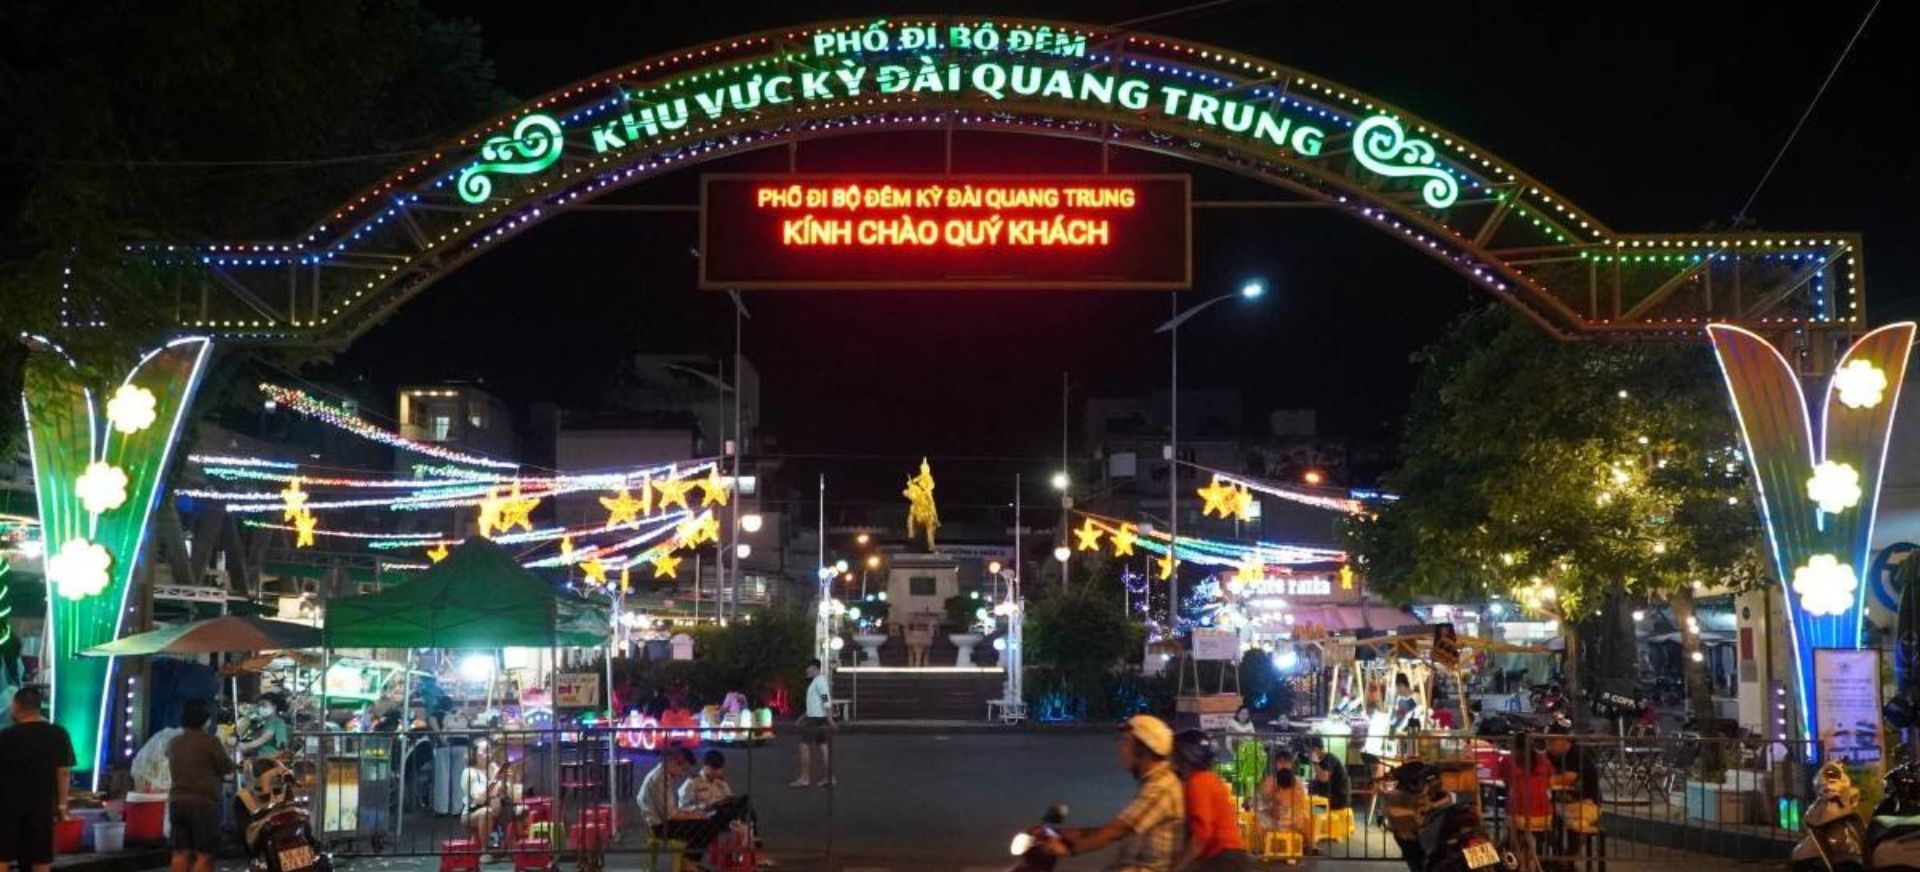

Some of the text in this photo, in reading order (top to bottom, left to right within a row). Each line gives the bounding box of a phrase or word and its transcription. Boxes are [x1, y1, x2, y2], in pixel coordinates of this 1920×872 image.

[814, 20, 888, 56] PHỐ
[900, 27, 937, 50] ĐI
[1008, 26, 1086, 57] ĐÊM
[592, 98, 688, 153] KHU
[801, 59, 866, 99] KỲ
[876, 55, 961, 94] ĐÀI
[971, 63, 1151, 110] QUANG
[1161, 86, 1325, 157] TRUNG
[758, 185, 802, 207] PHỐ
[806, 189, 828, 207] ĐI
[832, 185, 860, 211] BỘ
[864, 185, 911, 207] ĐÊM
[946, 185, 982, 207] ĐÀI
[985, 188, 1059, 210] QUANG
[1063, 188, 1135, 207] TRUNG
[783, 214, 1108, 246] KÍNH CHÀO QUÝ KHÁCH
